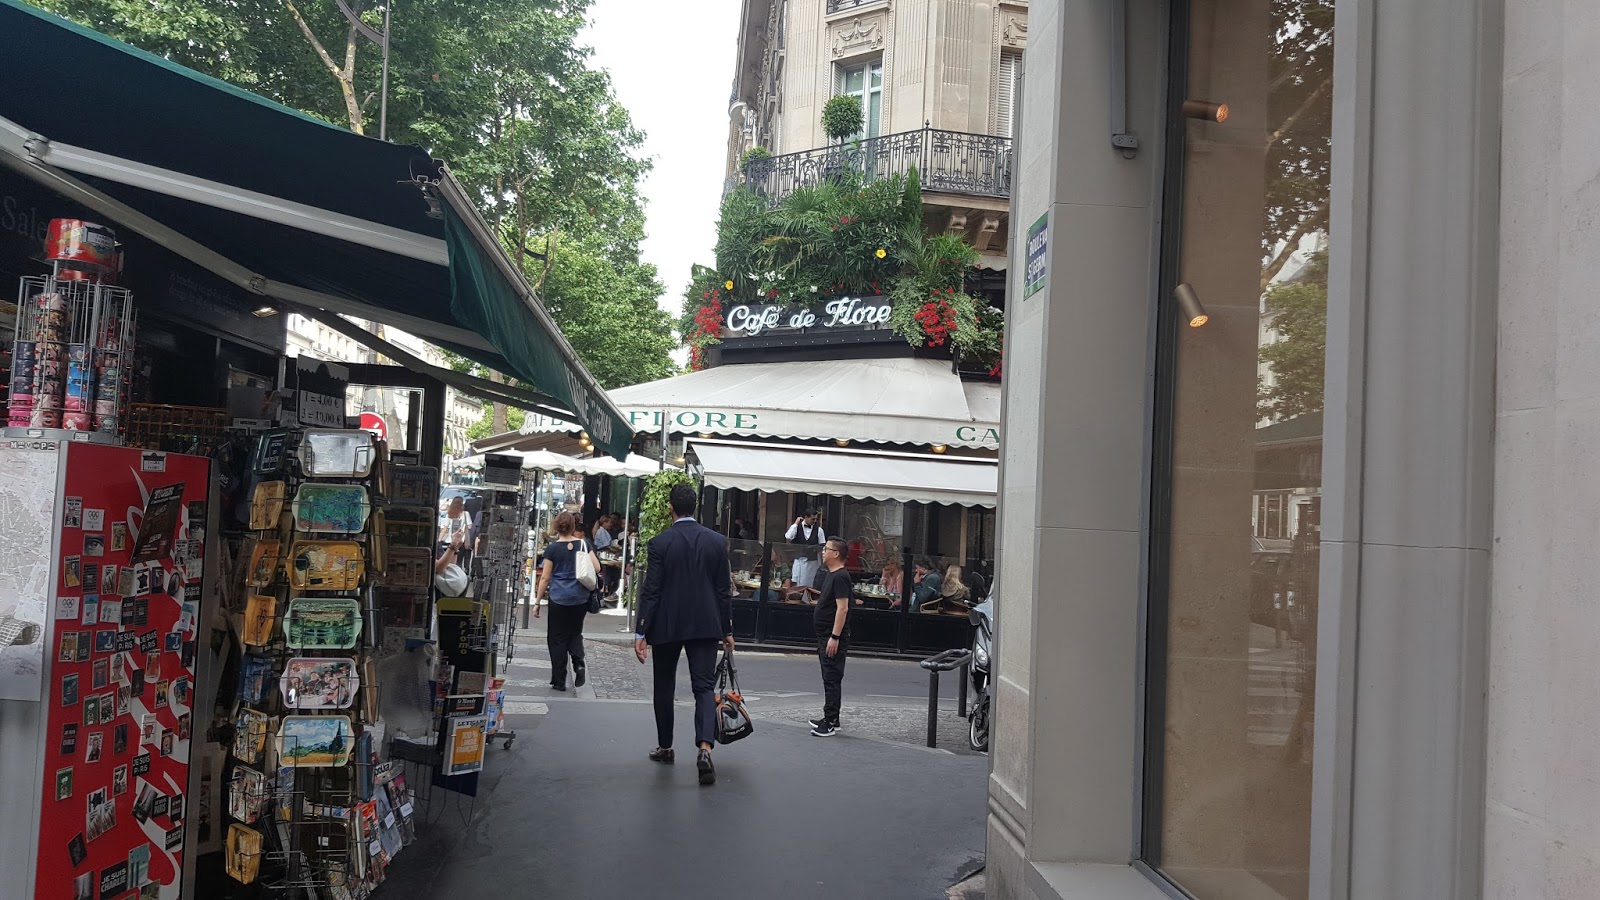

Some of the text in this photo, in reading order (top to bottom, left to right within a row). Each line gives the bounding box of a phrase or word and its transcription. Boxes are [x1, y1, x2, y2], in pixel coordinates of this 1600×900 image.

[727, 297, 892, 336] Café de Flore
[301, 408, 307, 419] 3
[316, 411, 335, 424] 10,00
[629, 411, 758, 430] FLORE
[458, 621, 468, 655] Promo
[101, 868, 127, 884] JE SUIS
[101, 875, 126, 893] CHARLIE
